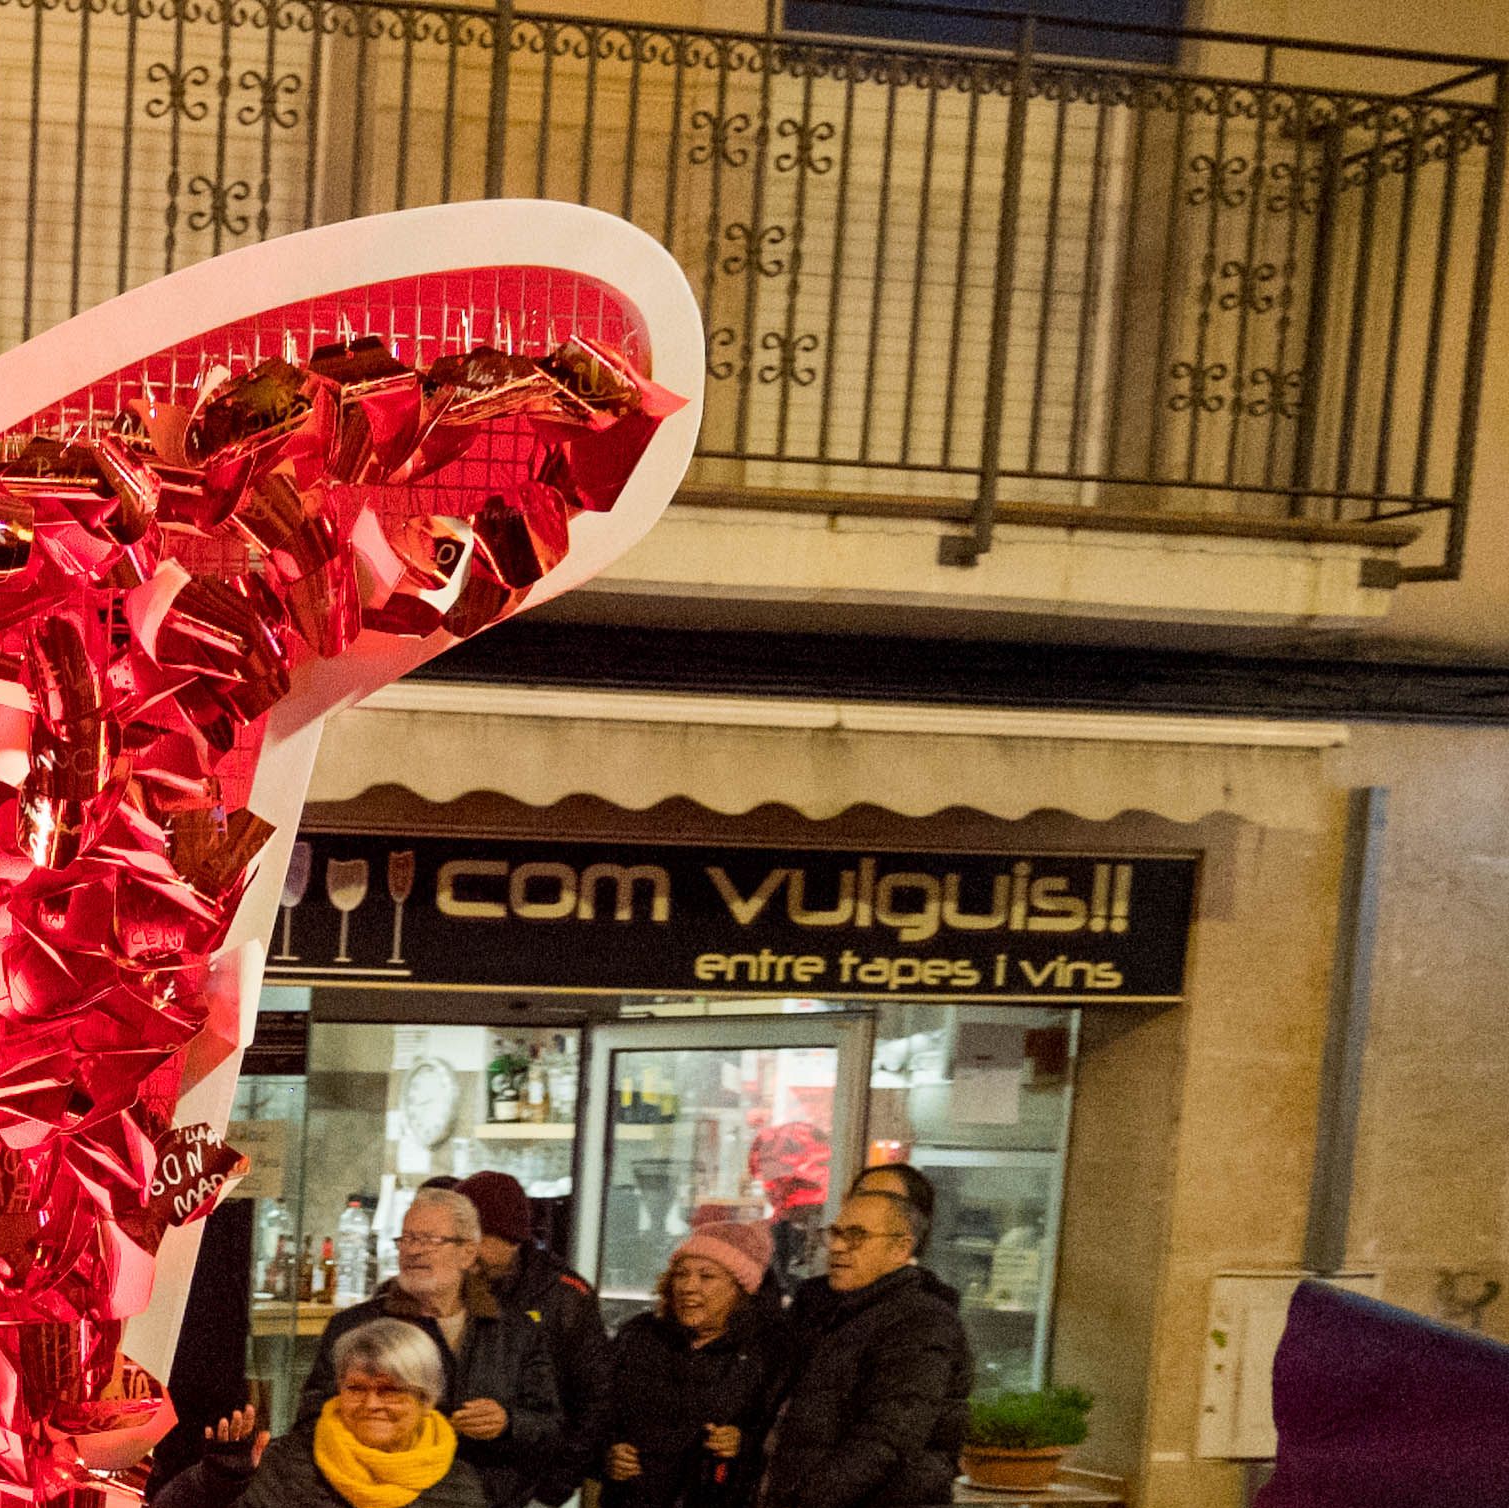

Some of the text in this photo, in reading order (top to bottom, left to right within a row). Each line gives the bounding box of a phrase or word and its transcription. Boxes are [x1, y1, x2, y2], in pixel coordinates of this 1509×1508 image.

[694, 948, 1124, 990] entre tapes i vins
